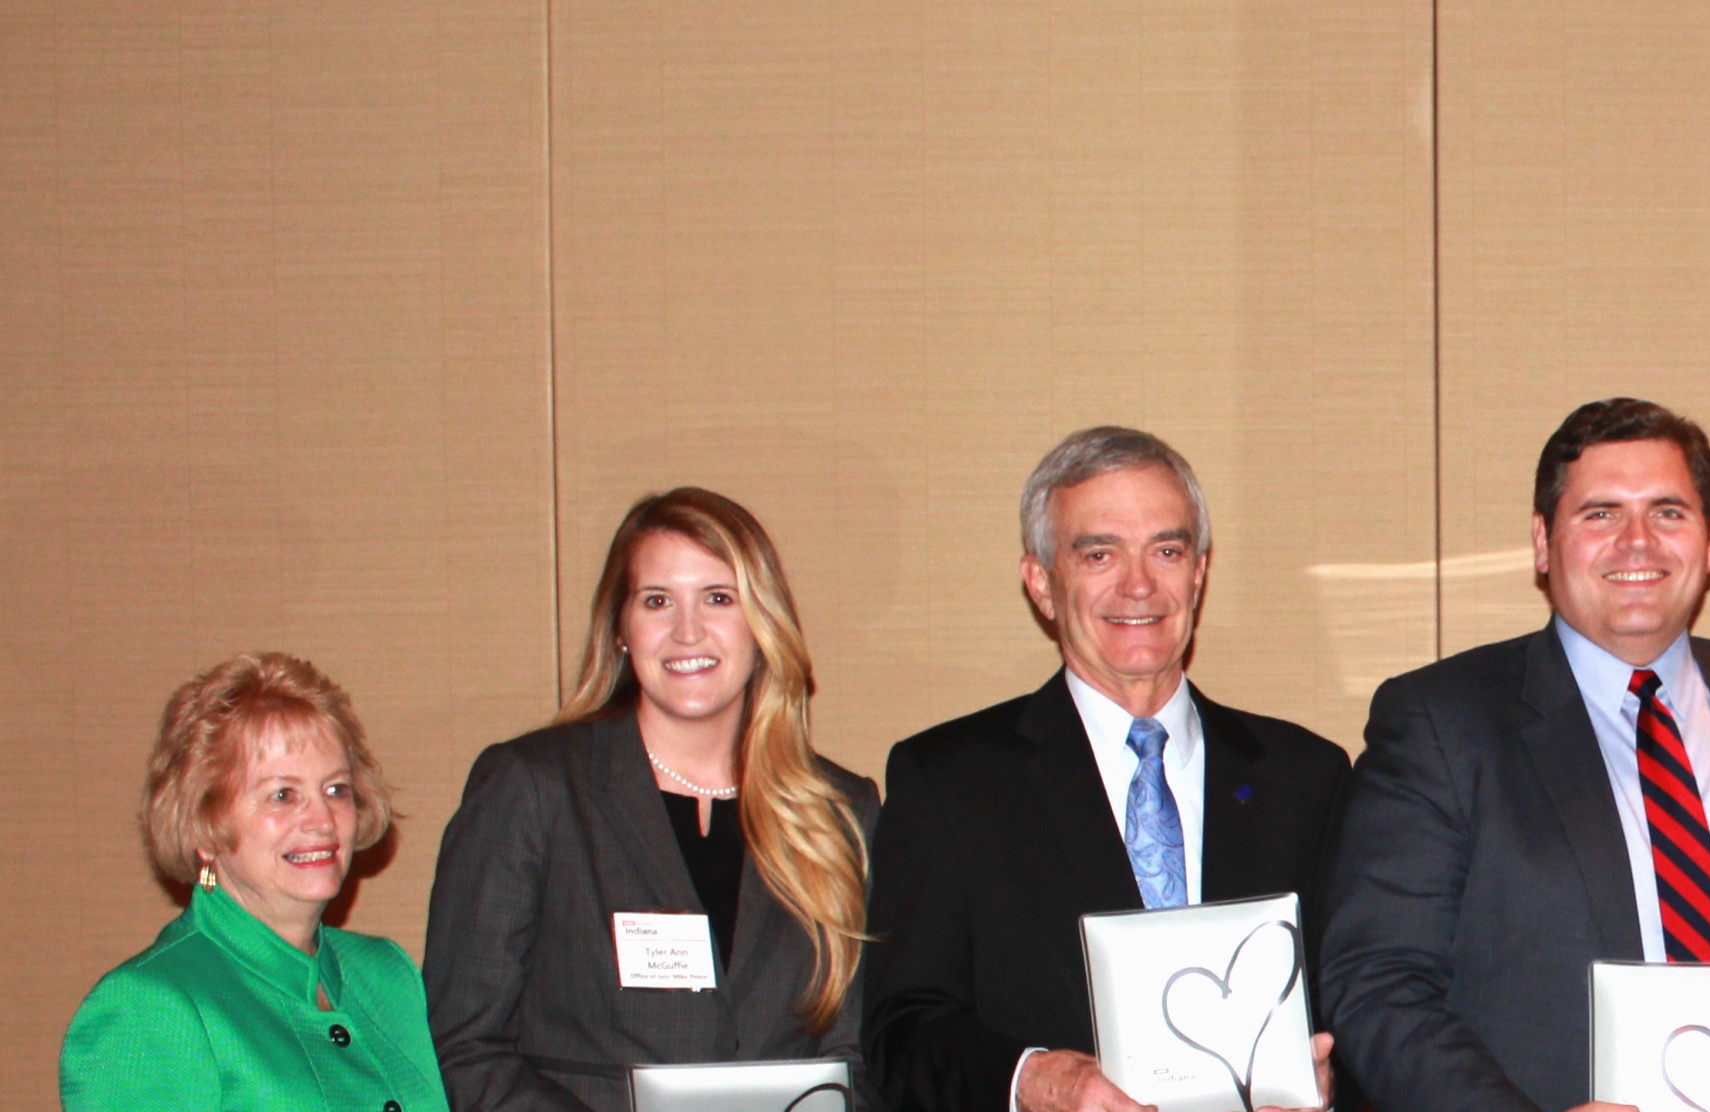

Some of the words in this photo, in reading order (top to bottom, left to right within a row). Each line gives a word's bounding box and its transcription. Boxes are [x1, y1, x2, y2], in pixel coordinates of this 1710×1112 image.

[625, 927, 658, 935] Indiana
[645, 947, 667, 958] Tyler
[670, 948, 688, 956] Ann
[647, 961, 689, 970] McGuffie
